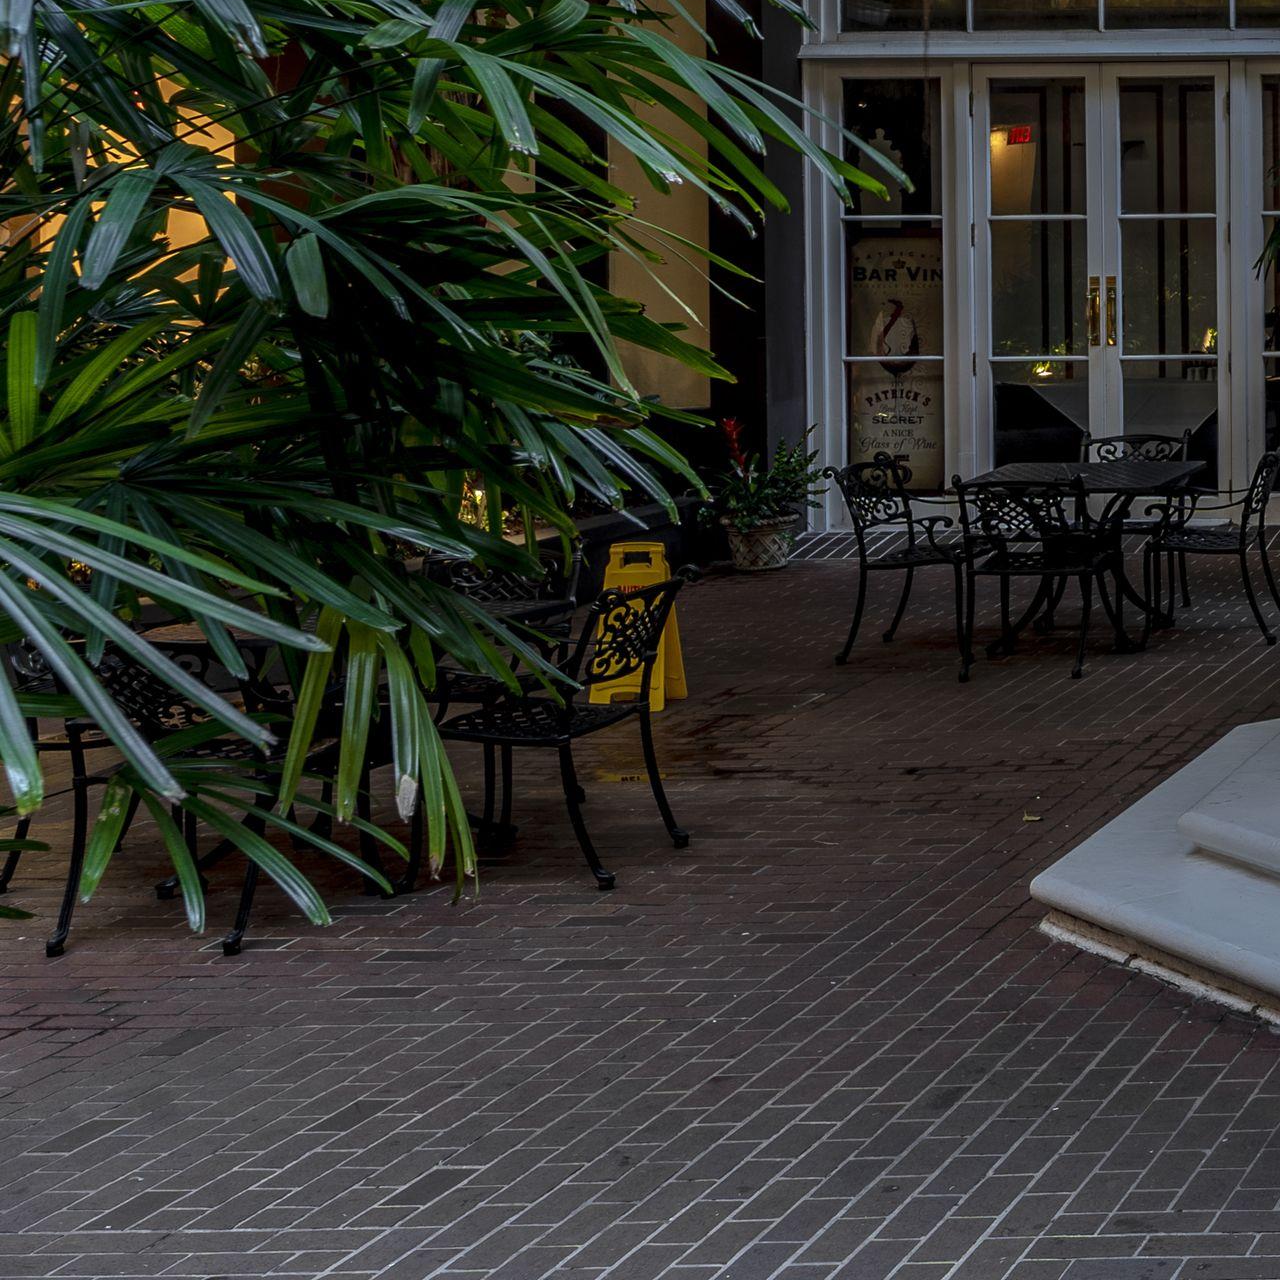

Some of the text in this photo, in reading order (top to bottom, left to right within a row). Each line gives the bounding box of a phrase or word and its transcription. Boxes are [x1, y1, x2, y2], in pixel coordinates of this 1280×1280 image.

[853, 266, 898, 281] BAR
[865, 388, 931, 407] PATRICK'S
[872, 416, 925, 425] SECRET
[891, 429, 914, 437] NICE
[861, 437, 937, 452] Glass of Wine
